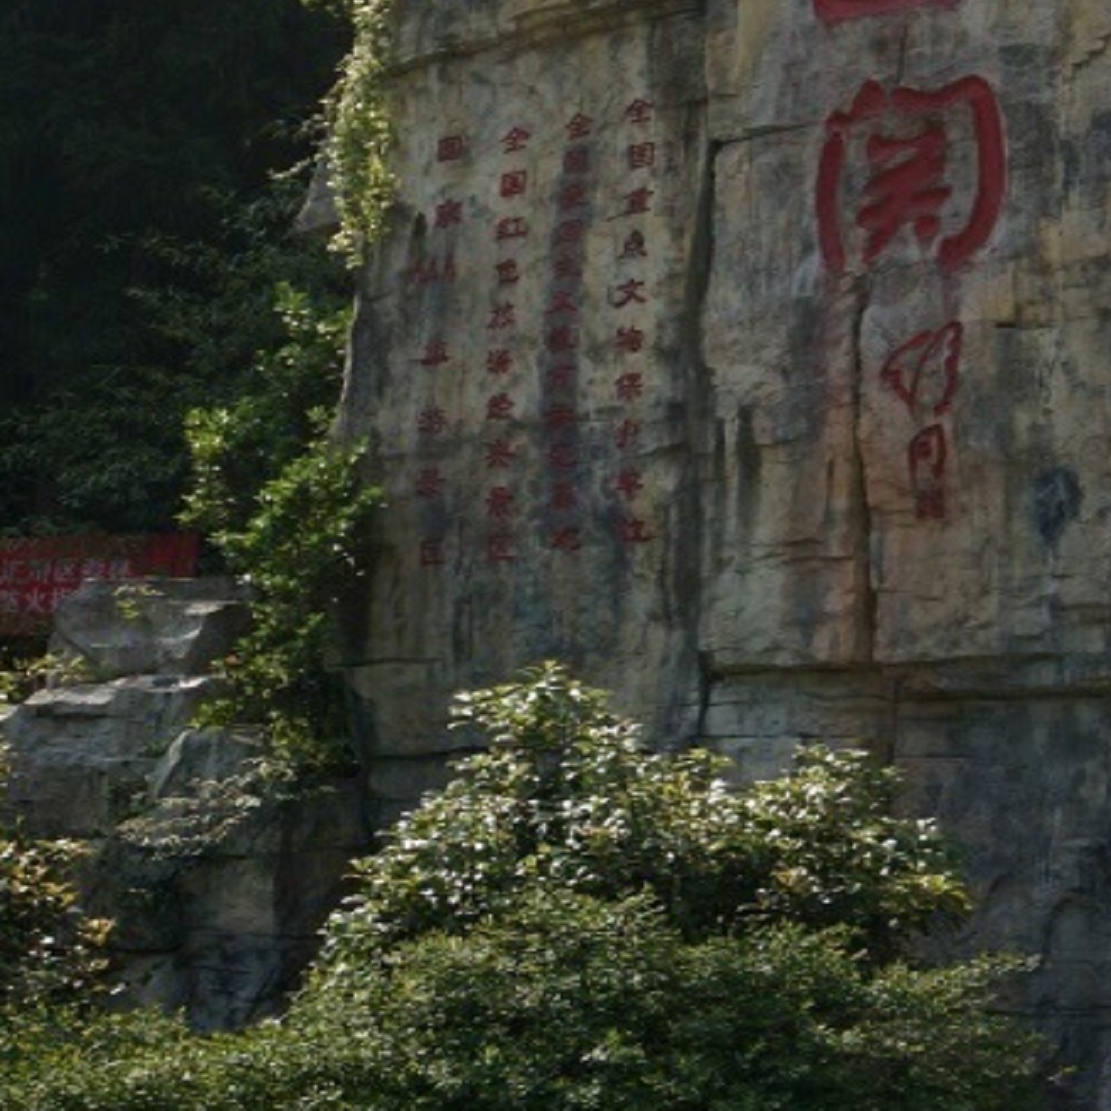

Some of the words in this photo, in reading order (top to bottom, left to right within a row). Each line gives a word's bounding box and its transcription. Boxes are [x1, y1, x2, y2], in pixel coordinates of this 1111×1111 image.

[610, 98, 656, 543] 全国重点文物保护单位
